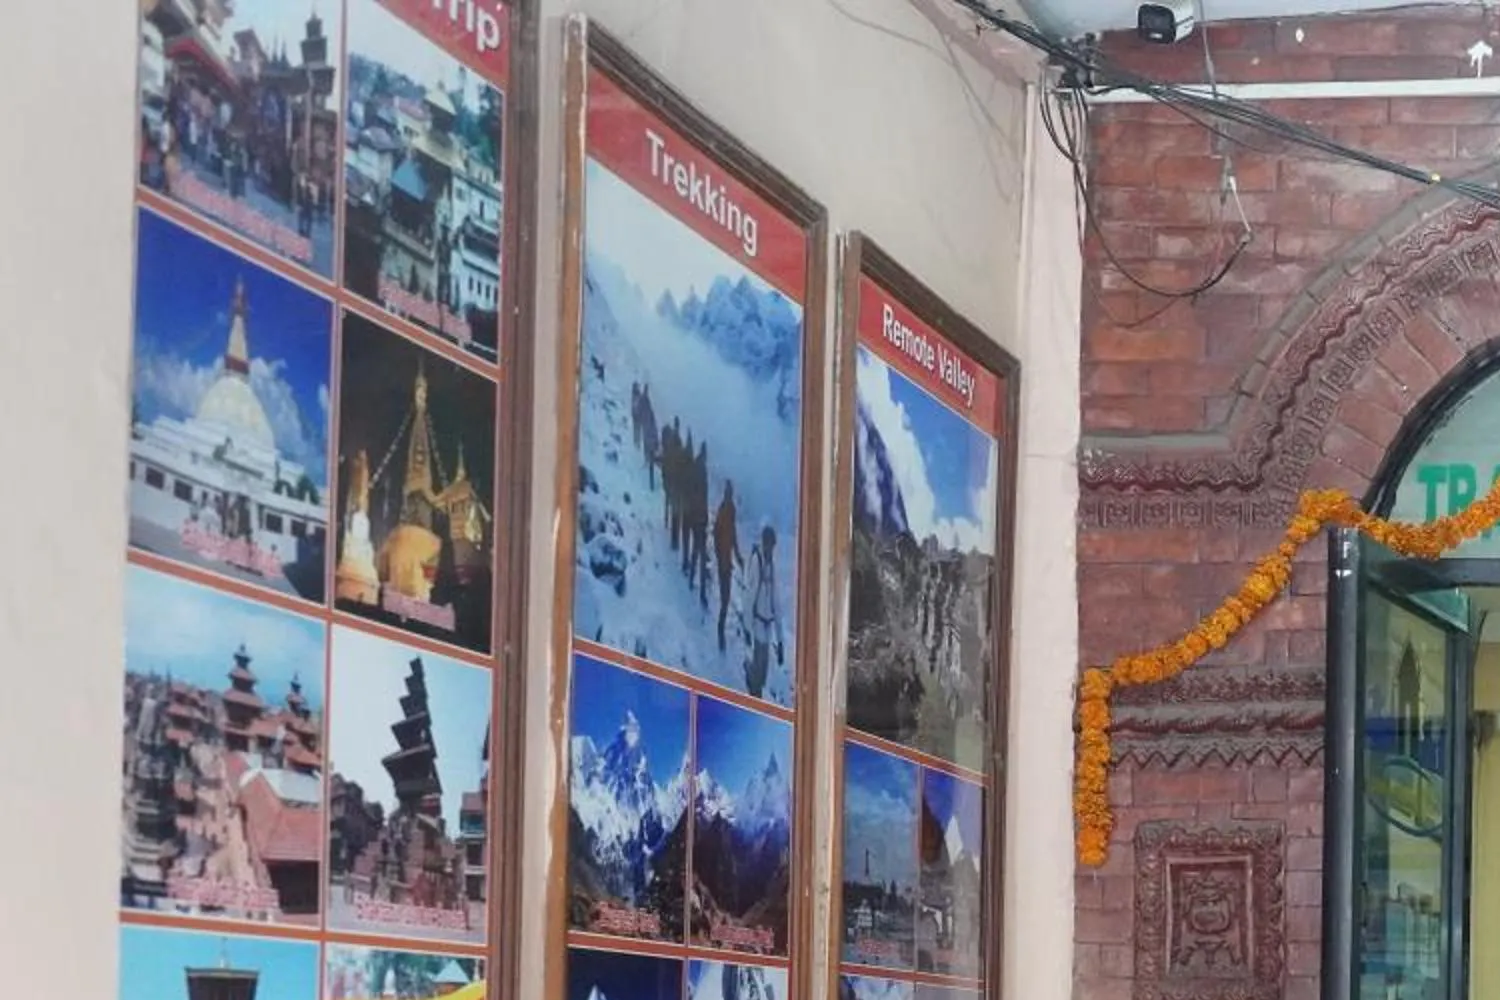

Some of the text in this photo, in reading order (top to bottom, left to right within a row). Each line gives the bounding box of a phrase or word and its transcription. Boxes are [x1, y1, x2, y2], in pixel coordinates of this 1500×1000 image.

[433, 0, 500, 52] rip
[646, 128, 758, 256] Trekking
[883, 303, 975, 407] Remote Valley
